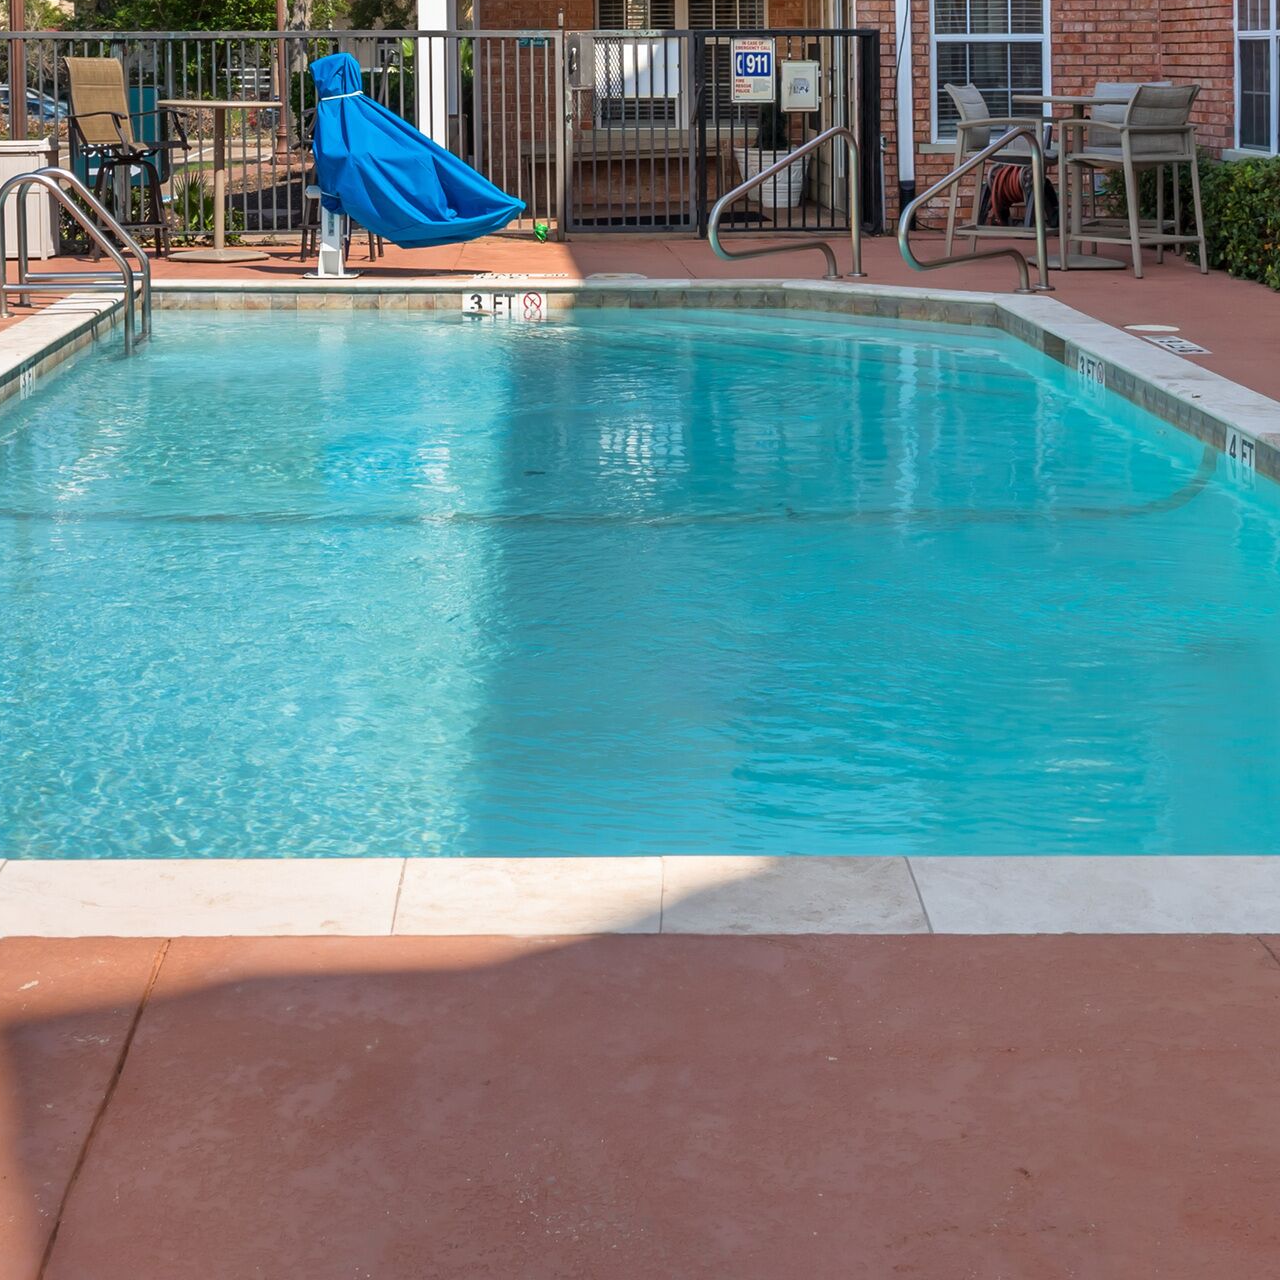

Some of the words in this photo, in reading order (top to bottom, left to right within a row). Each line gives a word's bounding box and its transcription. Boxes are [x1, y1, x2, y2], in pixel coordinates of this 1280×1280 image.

[746, 54, 768, 74] 911
[470, 293, 483, 310] 3
[493, 291, 516, 310] FT
[1079, 355, 1085, 375] 3
[1087, 359, 1096, 380] FT
[1229, 434, 1236, 459] 4
[1241, 439, 1254, 467] FT
